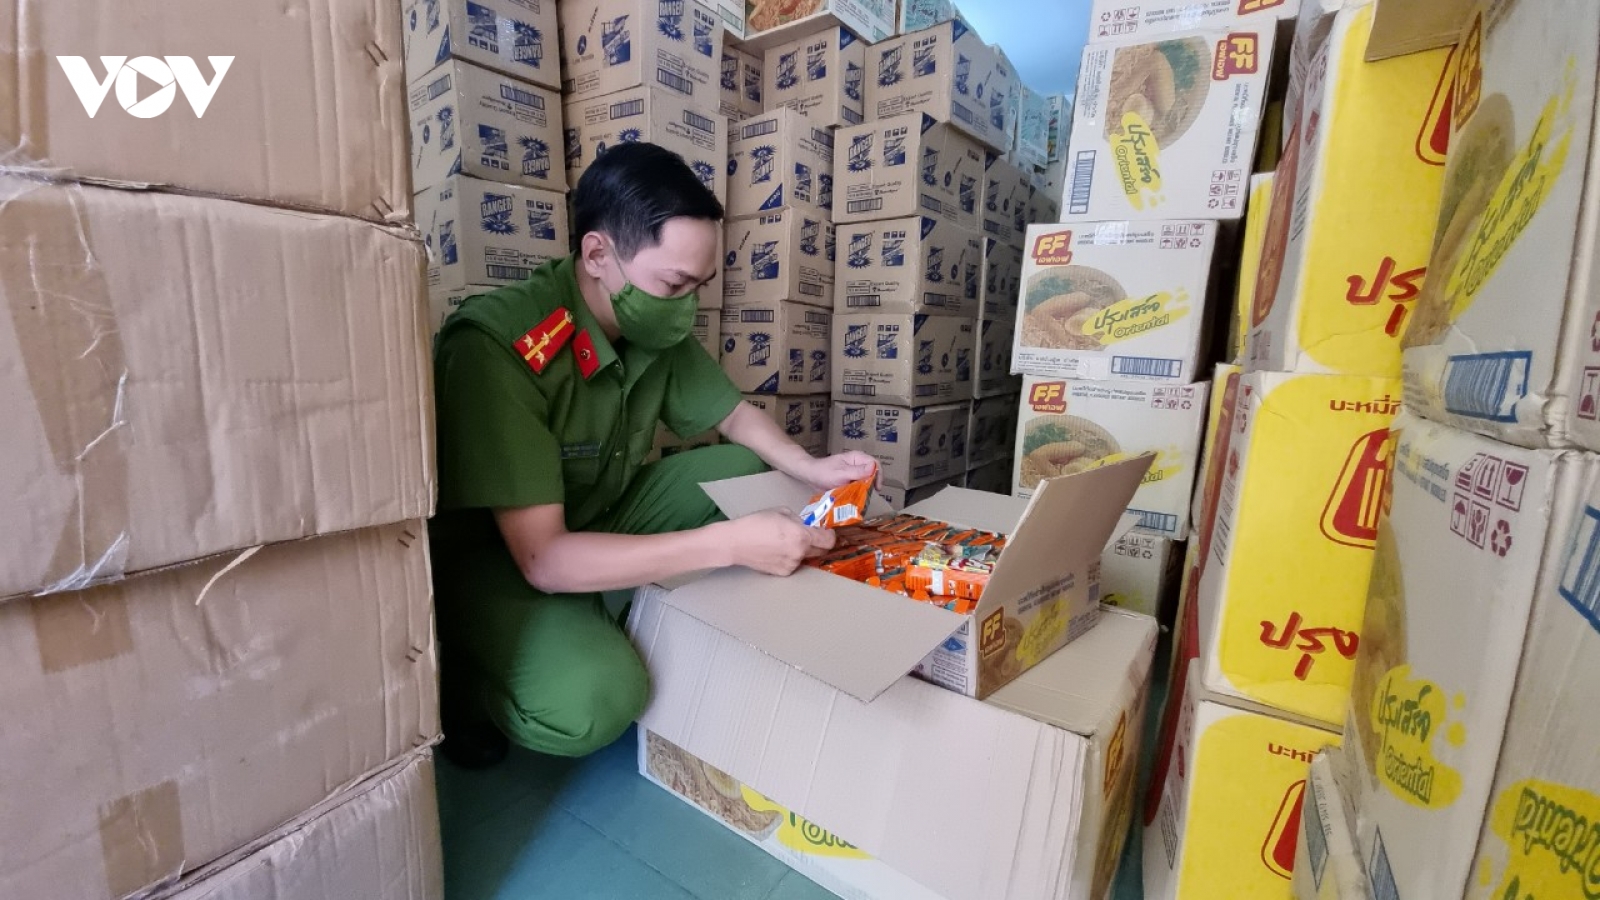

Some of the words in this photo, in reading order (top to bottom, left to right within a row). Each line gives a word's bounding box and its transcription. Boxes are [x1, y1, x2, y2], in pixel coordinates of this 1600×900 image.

[1229, 37, 1254, 69] FF
[522, 156, 550, 175] RANGER
[1116, 145, 1138, 194] Oriental
[481, 195, 513, 219] RANGER
[1037, 234, 1067, 256] FF
[1113, 313, 1170, 338] Oriental
[1033, 384, 1061, 402] FF
[984, 613, 1001, 645] FF
